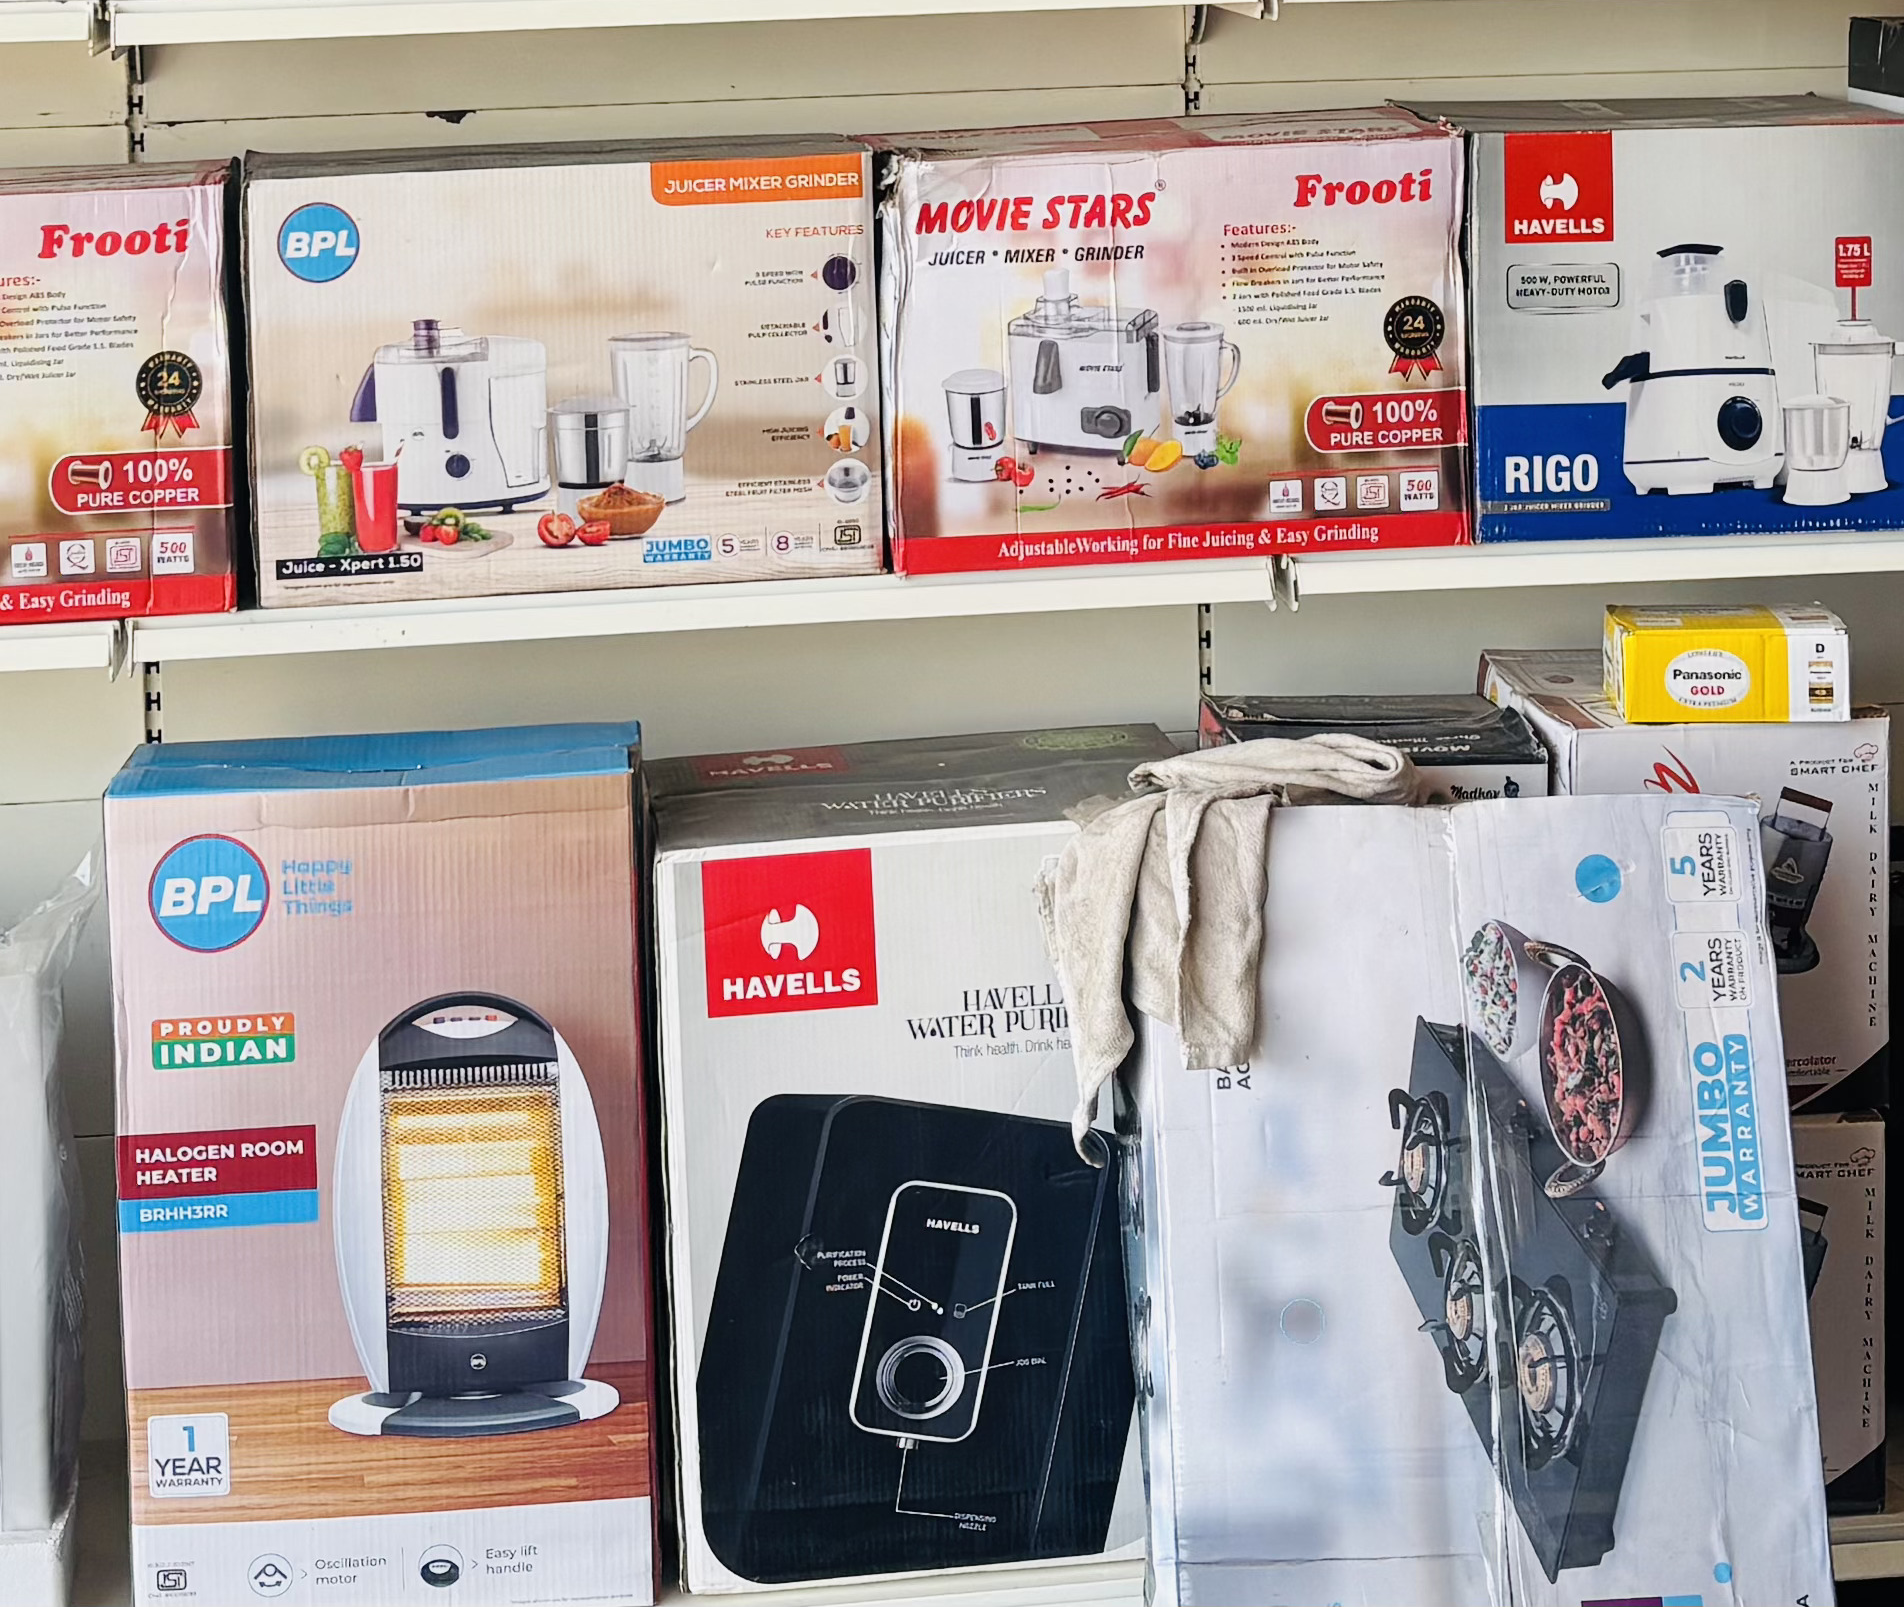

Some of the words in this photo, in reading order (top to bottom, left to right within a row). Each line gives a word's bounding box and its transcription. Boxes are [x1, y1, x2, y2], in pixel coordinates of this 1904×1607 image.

[664, 177, 726, 194] JUICER
[729, 175, 782, 192] MIXER
[786, 172, 858, 190] GRINDER
[766, 227, 792, 239] KEY
[796, 224, 864, 238] FEATURES
[1514, 218, 1604, 235] HAVELLS
[38, 219, 189, 260] Frooti
[1554, 275, 1605, 284] POWERFUL
[1505, 454, 1598, 493] RIGO
[645, 538, 709, 554] JUMBO
[282, 559, 324, 573] Juice
[340, 556, 384, 574] Xpert
[388, 554, 421, 569] 1.50
[0, 595, 13, 610] &
[19, 593, 54, 613] Easy
[59, 588, 130, 609] Grinding
[1673, 669, 1742, 682] Panasonic
[1691, 686, 1724, 696] GOLD
[1701, 832, 1716, 896] YEARS
[159, 875, 263, 916] BPL
[723, 968, 861, 1001] HAVELLS
[962, 983, 1064, 1012] HAVELL
[906, 1012, 997, 1041] WATER
[1005, 1007, 1071, 1036] PURI
[954, 1044, 981, 1059] Think
[1026, 1039, 1053, 1054] Drink
[1692, 1041, 1734, 1213] JUMBO
[135, 1144, 234, 1163] HALOGEN
[240, 1139, 305, 1159] ROOM
[136, 1166, 216, 1186] HEATER
[139, 1203, 228, 1222] BRHH3RR
[315, 1555, 387, 1570] Oscillation
[485, 1548, 514, 1563] Easy
[519, 1545, 539, 1558] lift
